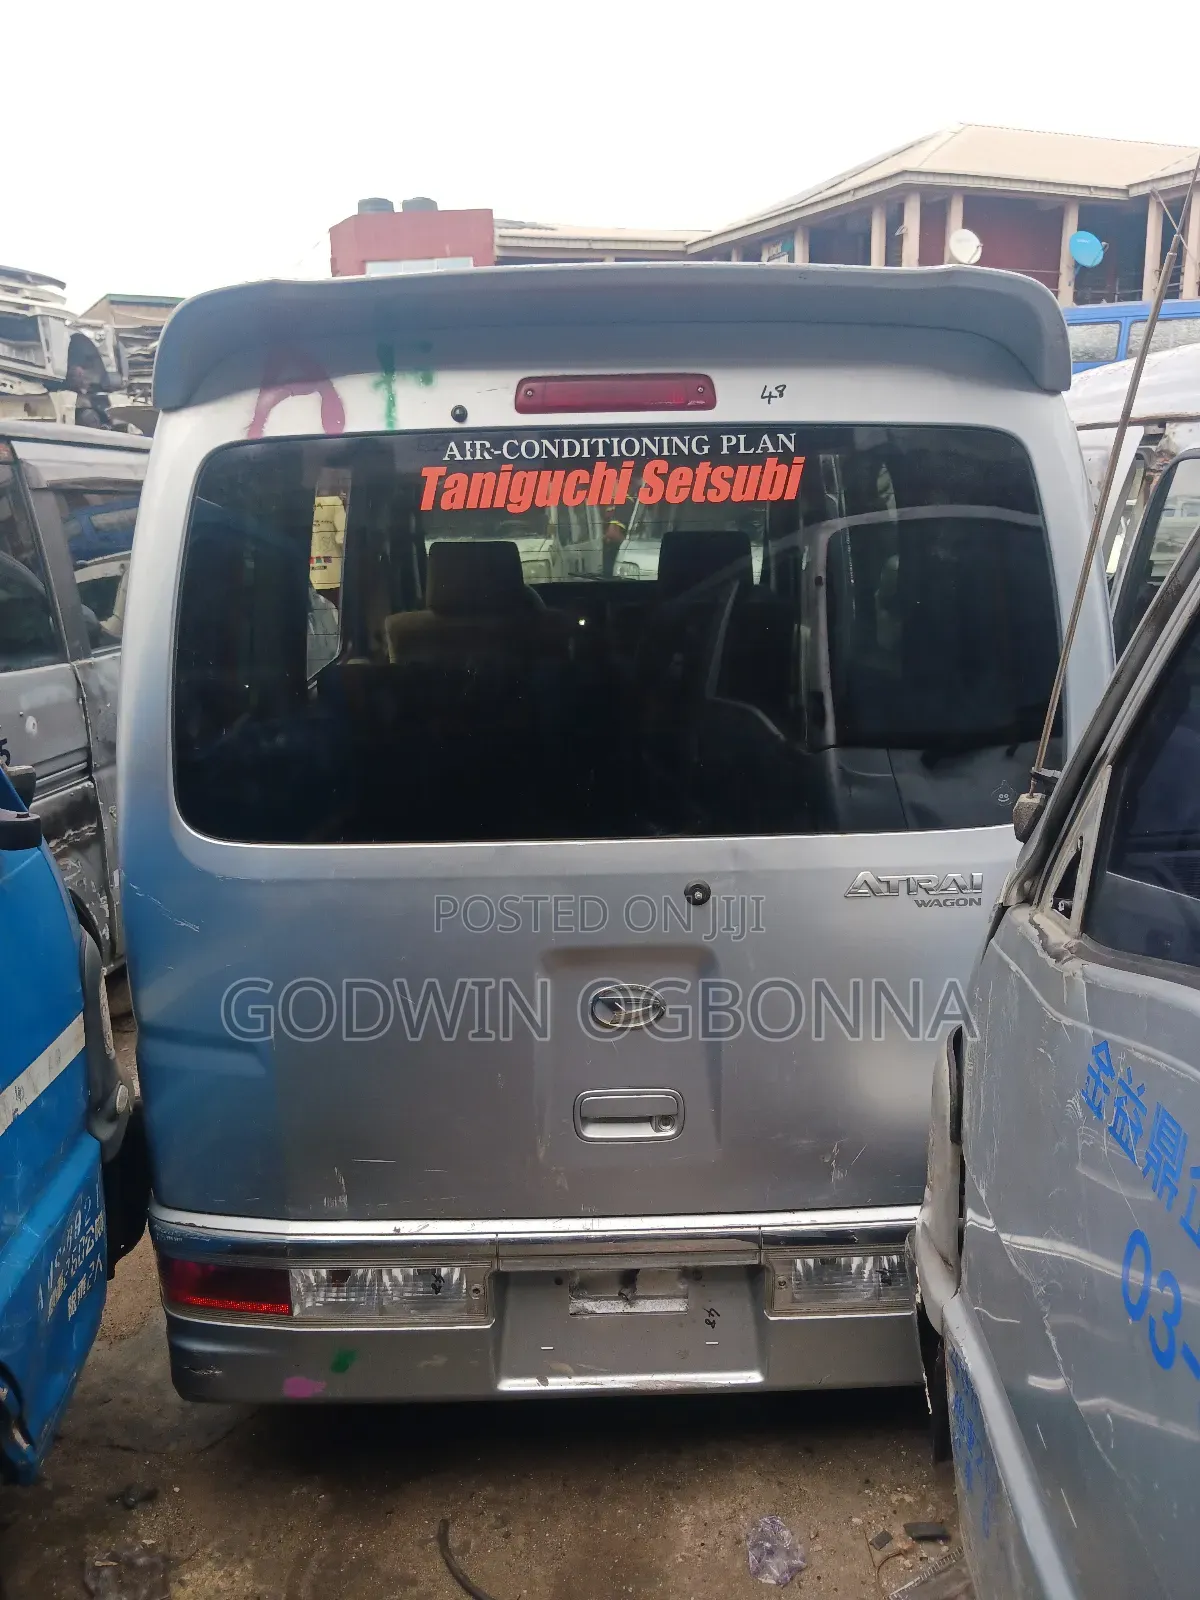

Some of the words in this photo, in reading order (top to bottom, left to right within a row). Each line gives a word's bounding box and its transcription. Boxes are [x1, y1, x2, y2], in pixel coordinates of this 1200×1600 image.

[760, 383, 787, 405] 48
[443, 434, 711, 462] AIR-CONDITIONING
[720, 432, 797, 454] PLAN
[420, 460, 634, 514] Taniguchi
[640, 456, 806, 505] Setsubi
[844, 871, 983, 898] ATRAI
[914, 898, 982, 908] WAGON
